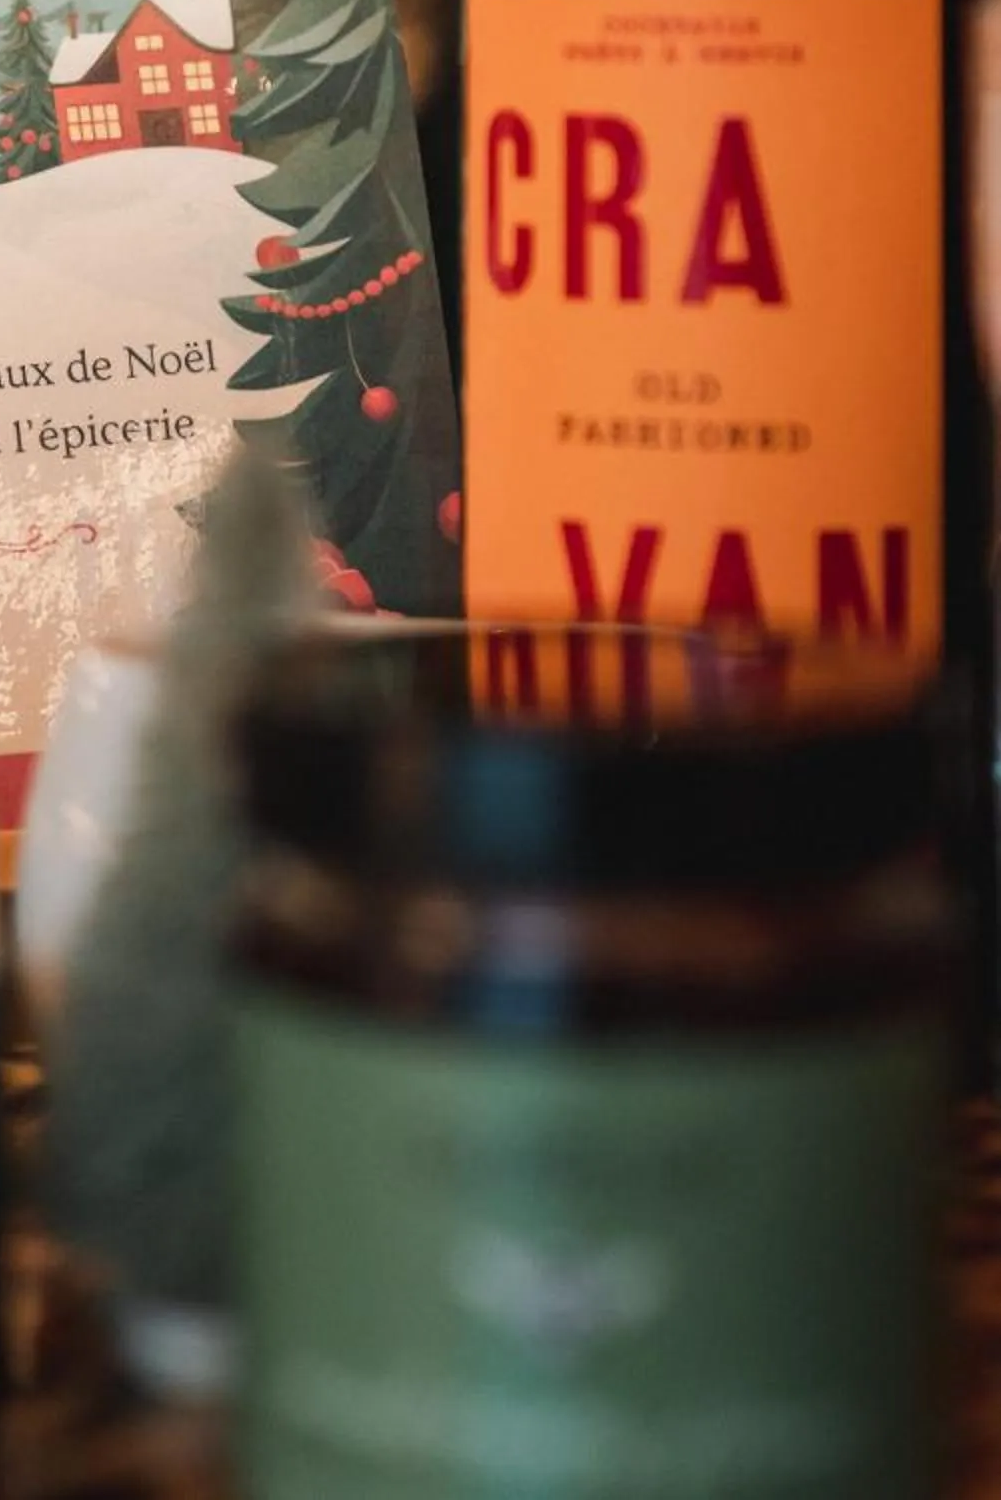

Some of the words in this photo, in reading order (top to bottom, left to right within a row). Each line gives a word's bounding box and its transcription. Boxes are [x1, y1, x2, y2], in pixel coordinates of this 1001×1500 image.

[486, 108, 790, 305] CRA
[66, 348, 113, 383] de
[123, 339, 217, 379] Noël
[632, 369, 723, 405] OLD
[13, 408, 196, 460] l'épicerie
